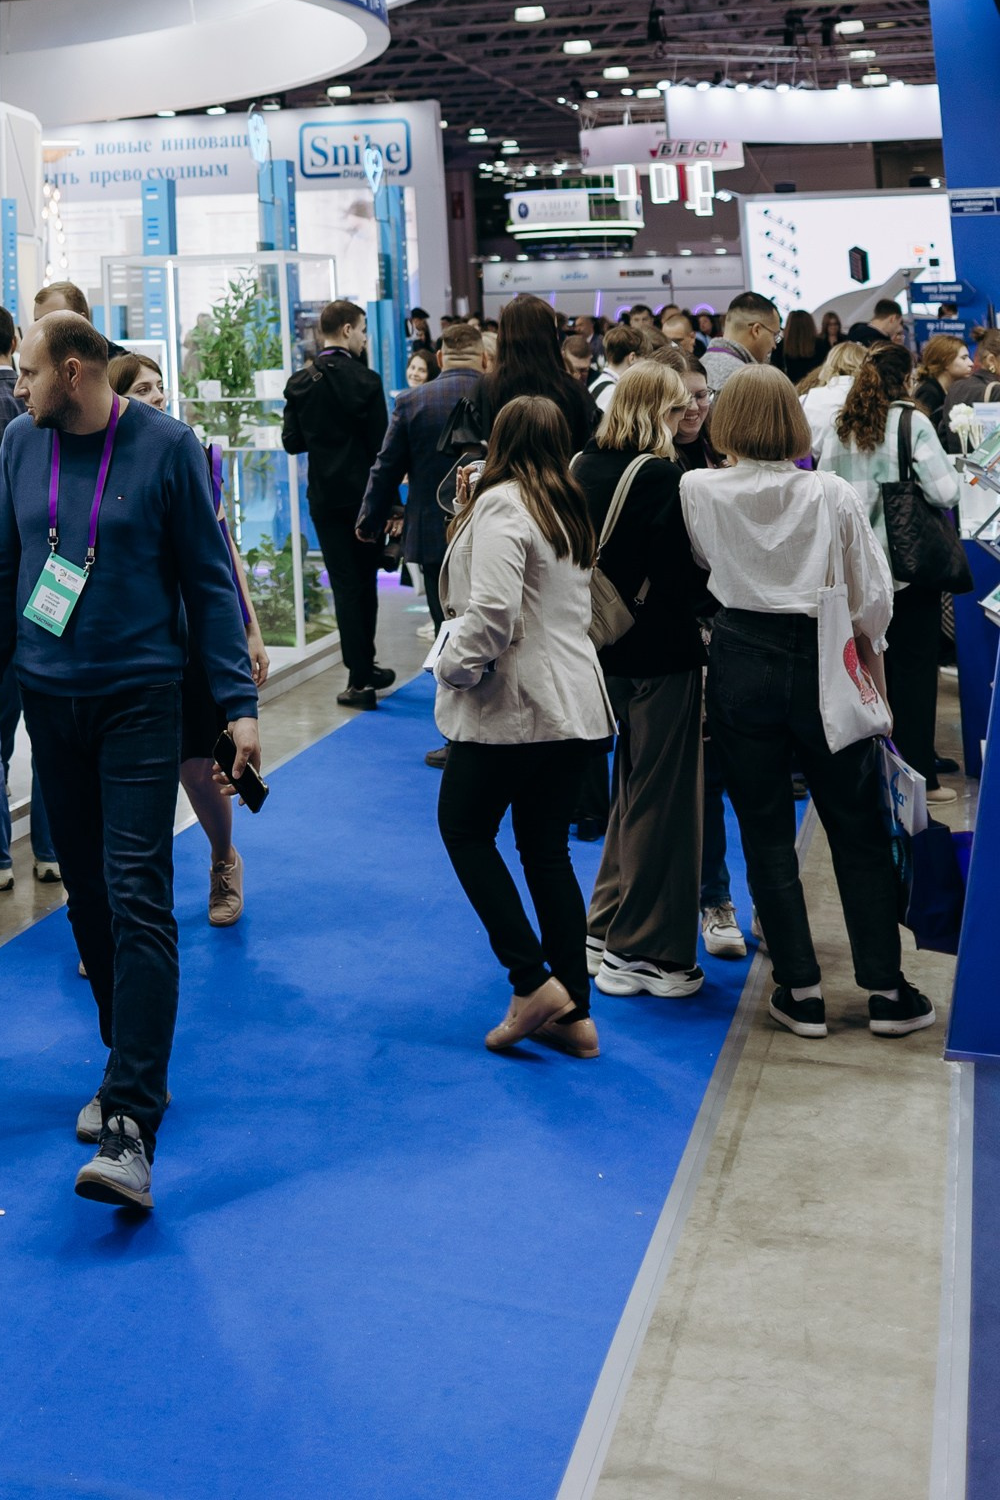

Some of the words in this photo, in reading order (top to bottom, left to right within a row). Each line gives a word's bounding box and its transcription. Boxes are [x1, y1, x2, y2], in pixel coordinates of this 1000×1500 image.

[95, 139, 152, 156] новые
[161, 134, 250, 151] инноваци
[659, 140, 722, 156] БЕСТ
